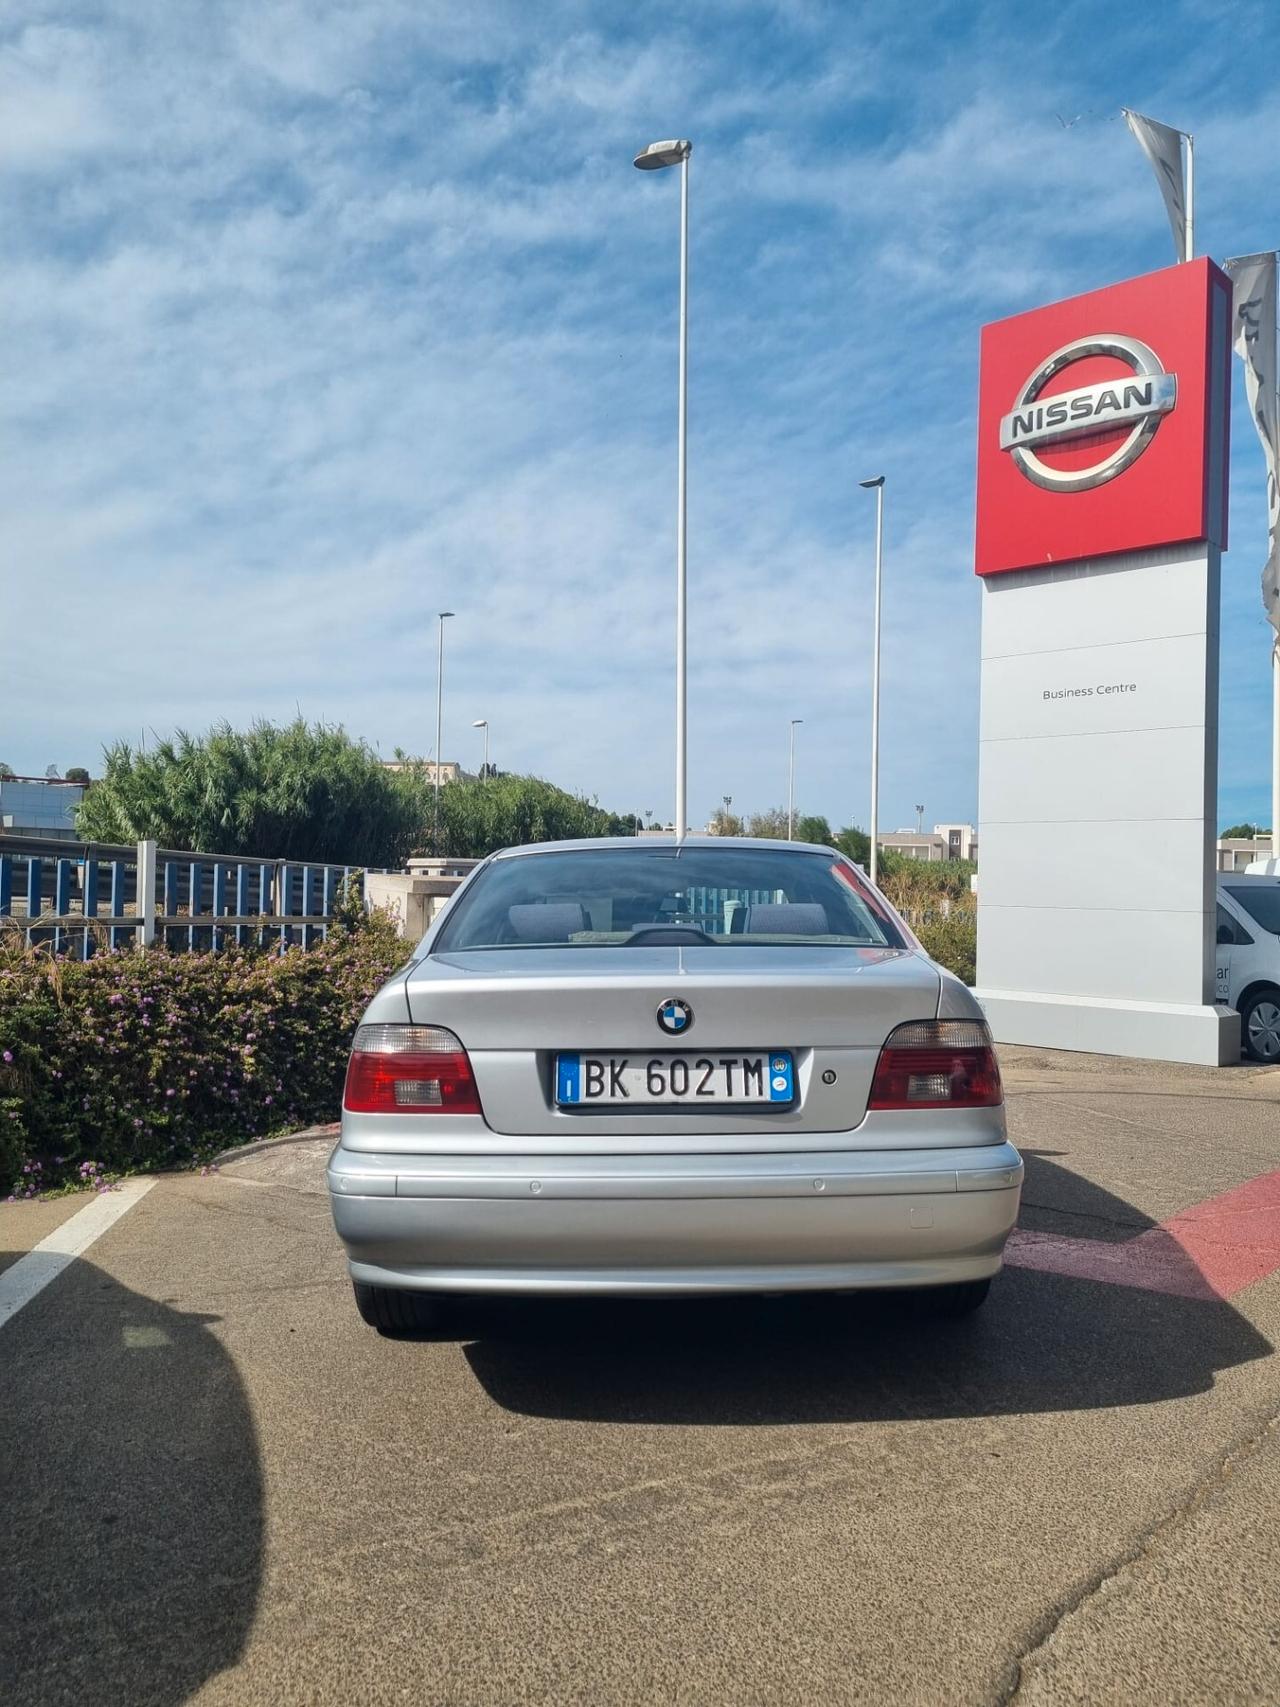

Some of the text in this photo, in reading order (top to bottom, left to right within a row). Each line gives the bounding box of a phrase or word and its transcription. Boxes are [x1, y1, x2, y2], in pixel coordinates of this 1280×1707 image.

[1012, 382, 1152, 438] NISSAN
[1043, 683, 1137, 700] Business Centre
[585, 1058, 763, 1097] BK 602TM
